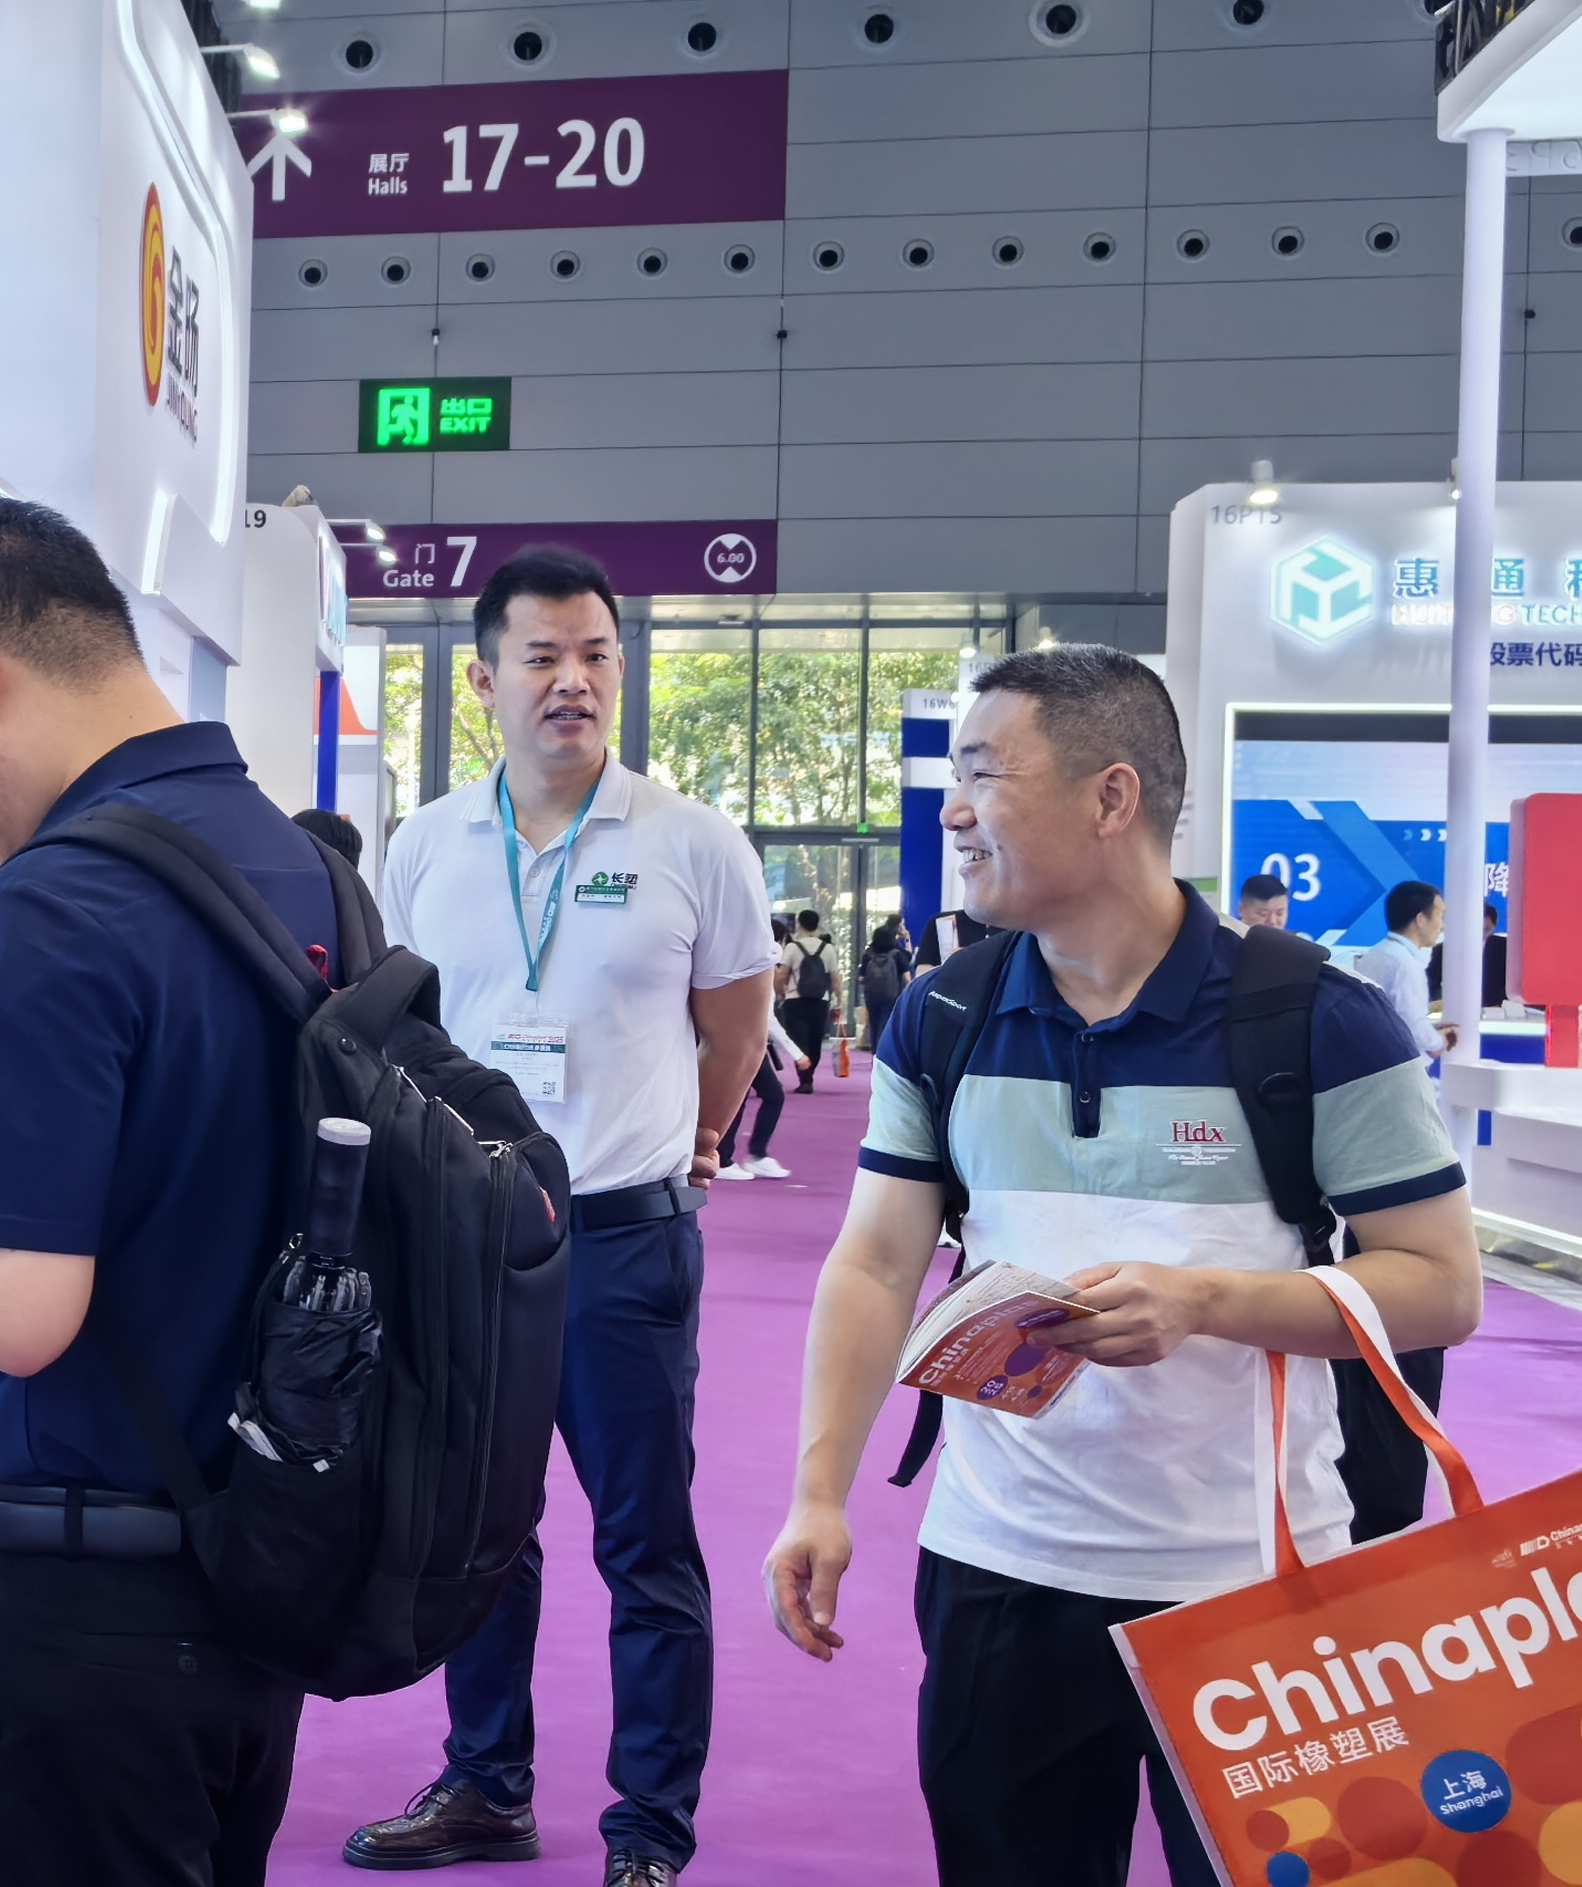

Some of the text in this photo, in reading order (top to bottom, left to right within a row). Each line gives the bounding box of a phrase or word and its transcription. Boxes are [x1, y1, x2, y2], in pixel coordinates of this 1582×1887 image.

[368, 117, 646, 196] Halls 17-20
[368, 153, 409, 174] 展厅
[439, 397, 493, 416] 出口
[439, 417, 491, 433] EXIT
[382, 536, 478, 589] Gate 7
[414, 543, 436, 564] 门
[1259, 852, 1322, 902] 03
[1170, 1119, 1226, 1143] Hdx
[1192, 1565, 1582, 1752] Chinapl
[1222, 1715, 1410, 1799] 国际橡塑展
[1439, 1785, 1505, 1816] Shanghai
[1442, 1769, 1487, 1801] 上海
